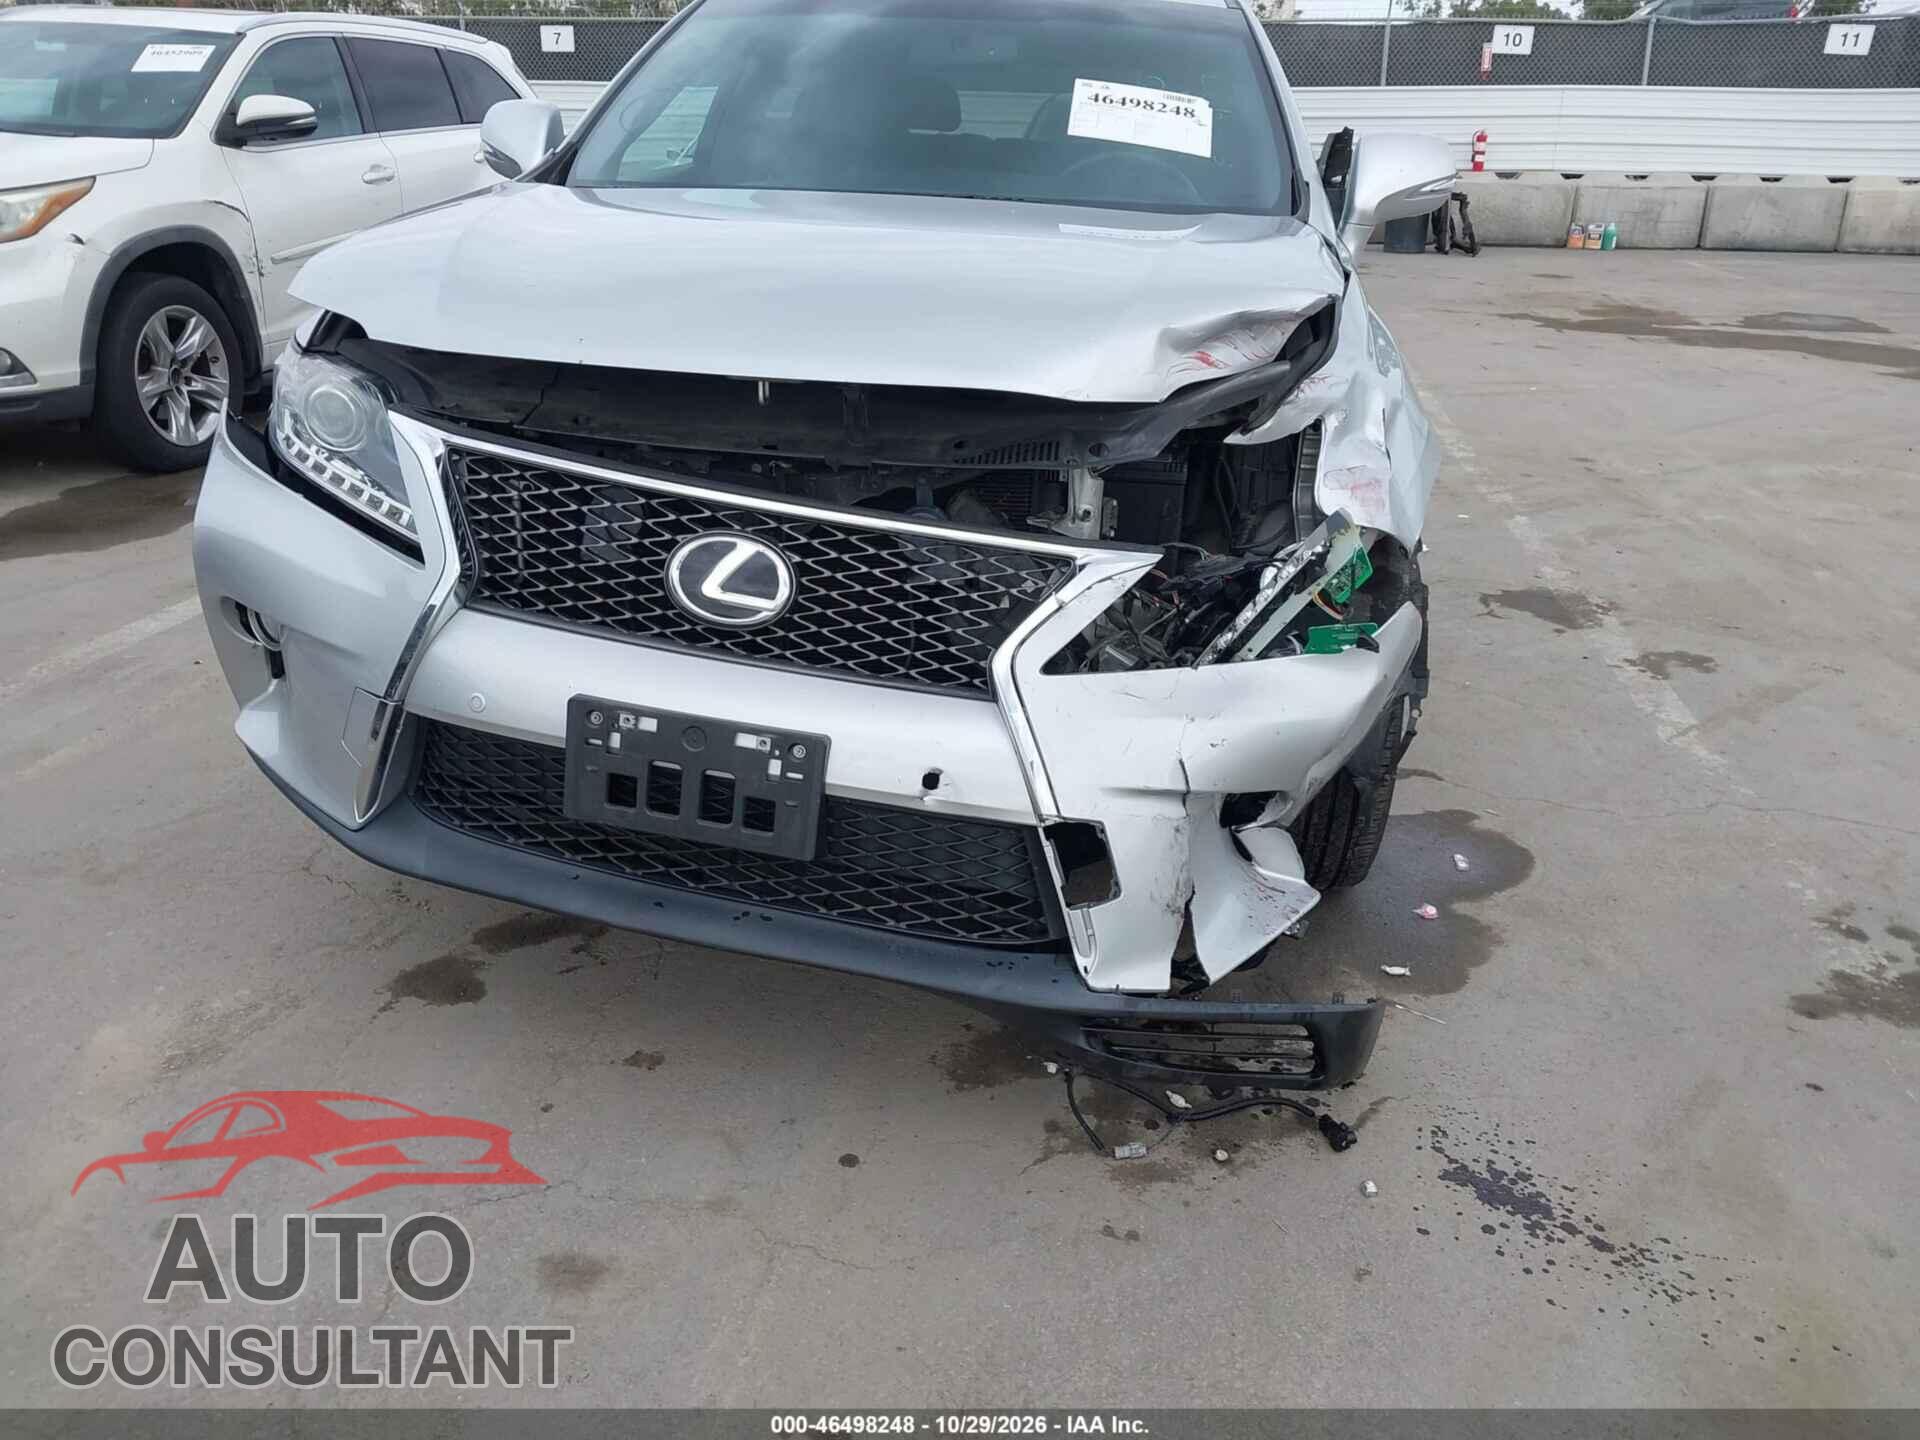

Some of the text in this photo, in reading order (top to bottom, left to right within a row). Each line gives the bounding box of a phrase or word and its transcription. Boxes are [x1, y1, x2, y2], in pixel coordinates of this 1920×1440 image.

[553, 32, 561, 45] 7
[1503, 32, 1522, 47] 10
[1841, 32, 1860, 47] 11
[1087, 92, 1197, 118] 46498248
